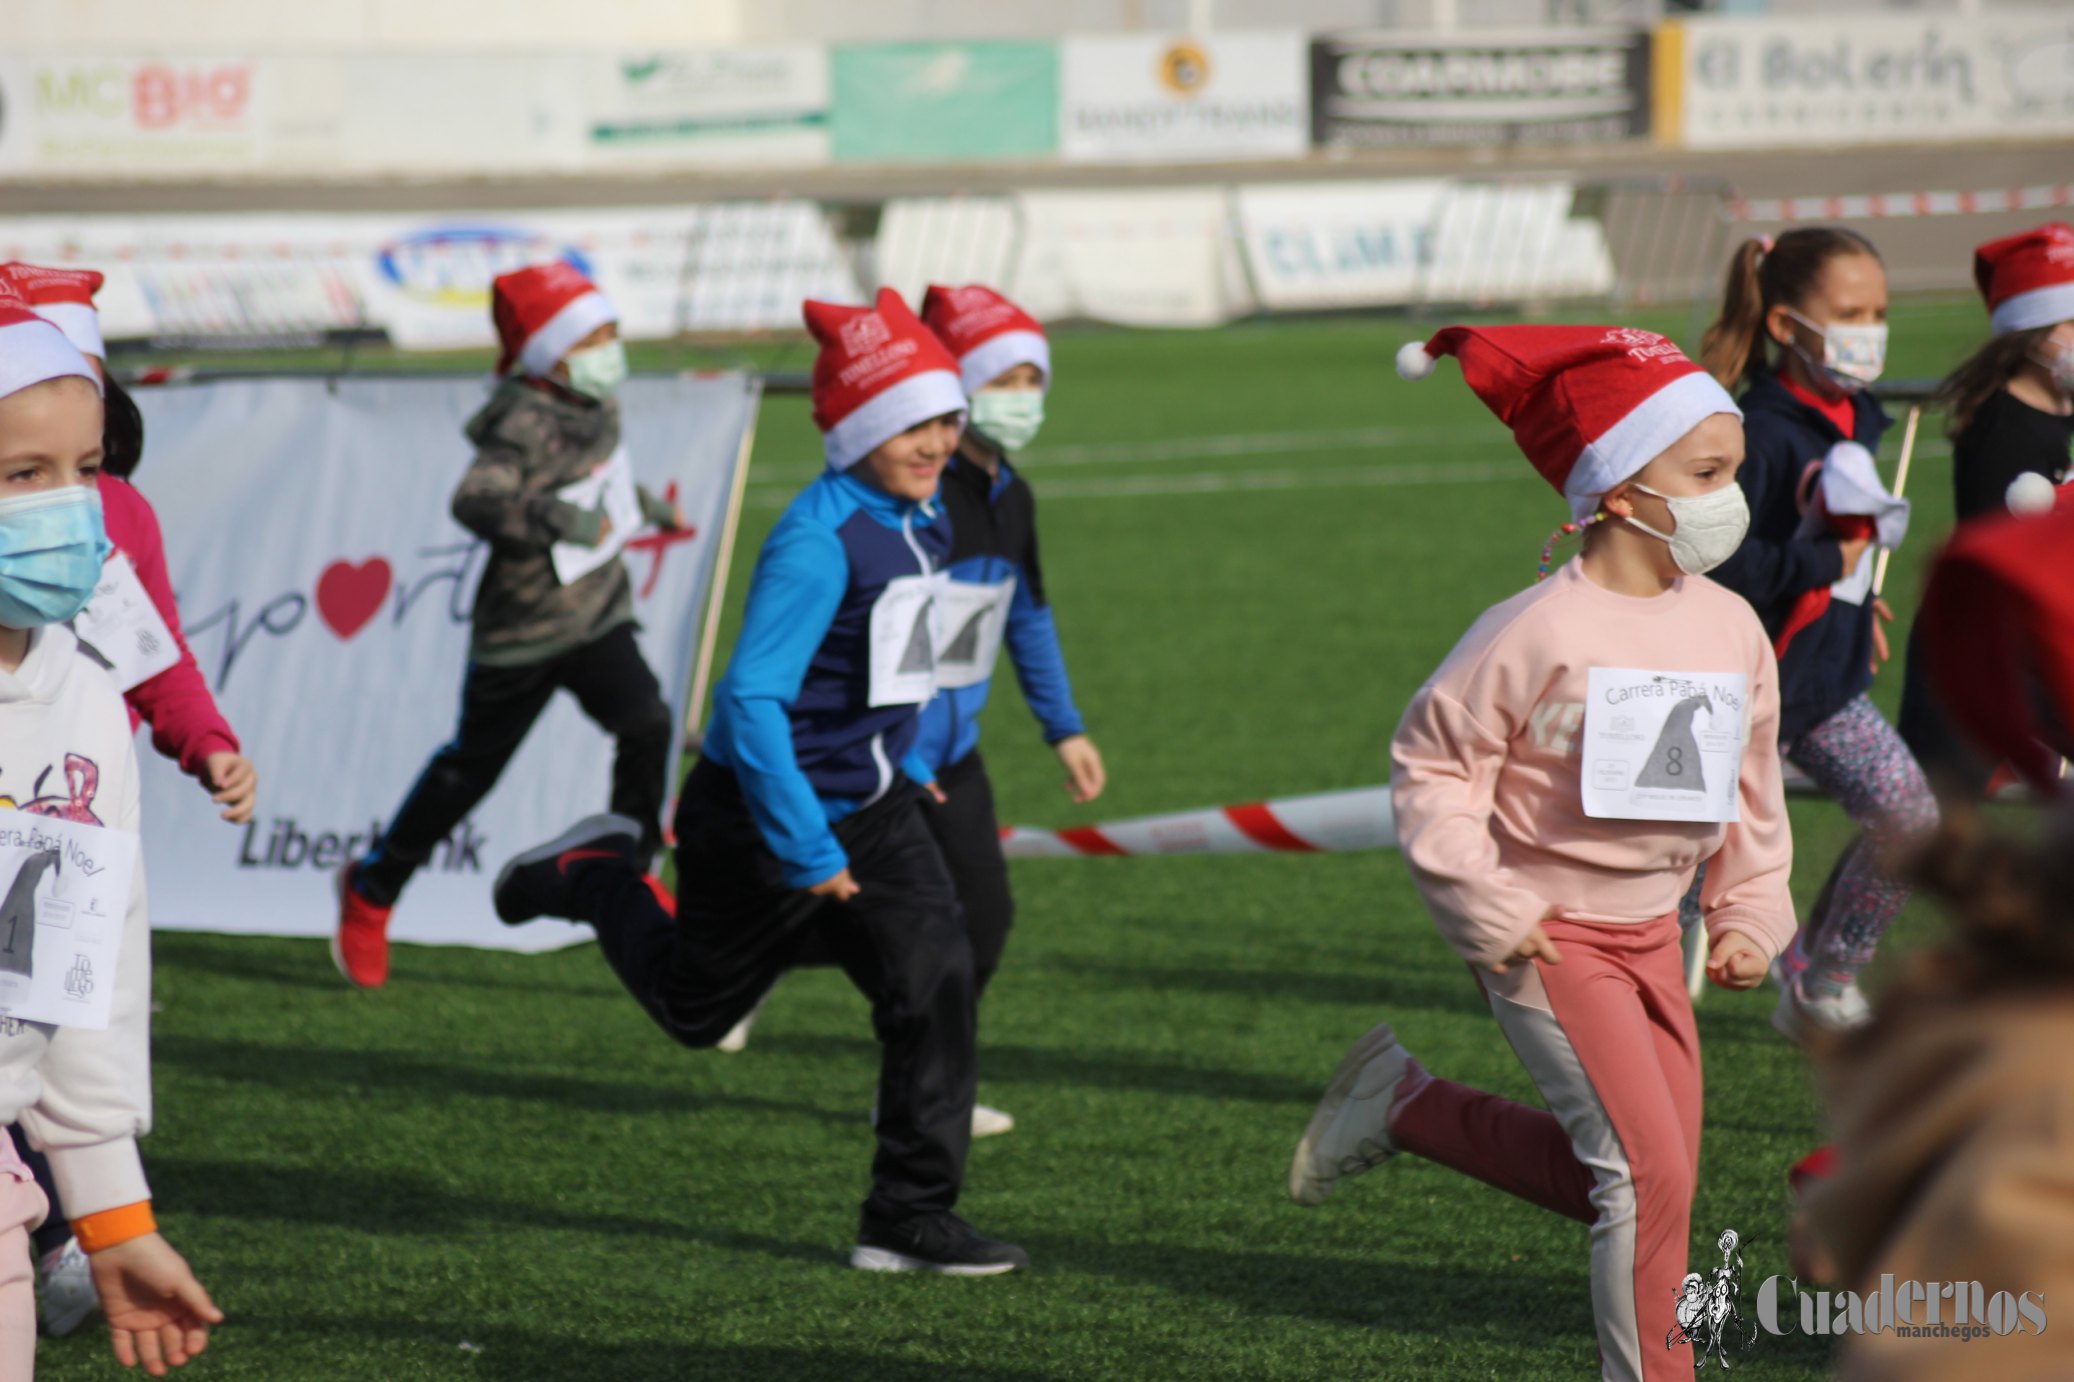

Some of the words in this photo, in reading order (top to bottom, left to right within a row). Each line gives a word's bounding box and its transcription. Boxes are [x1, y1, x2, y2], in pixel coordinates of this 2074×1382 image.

[1605, 683, 1664, 706] Carrera
[1665, 745, 1684, 776] 8
[0, 829, 22, 848] era
[65, 838, 105, 877] Noel
[3, 915, 18, 954] 1
